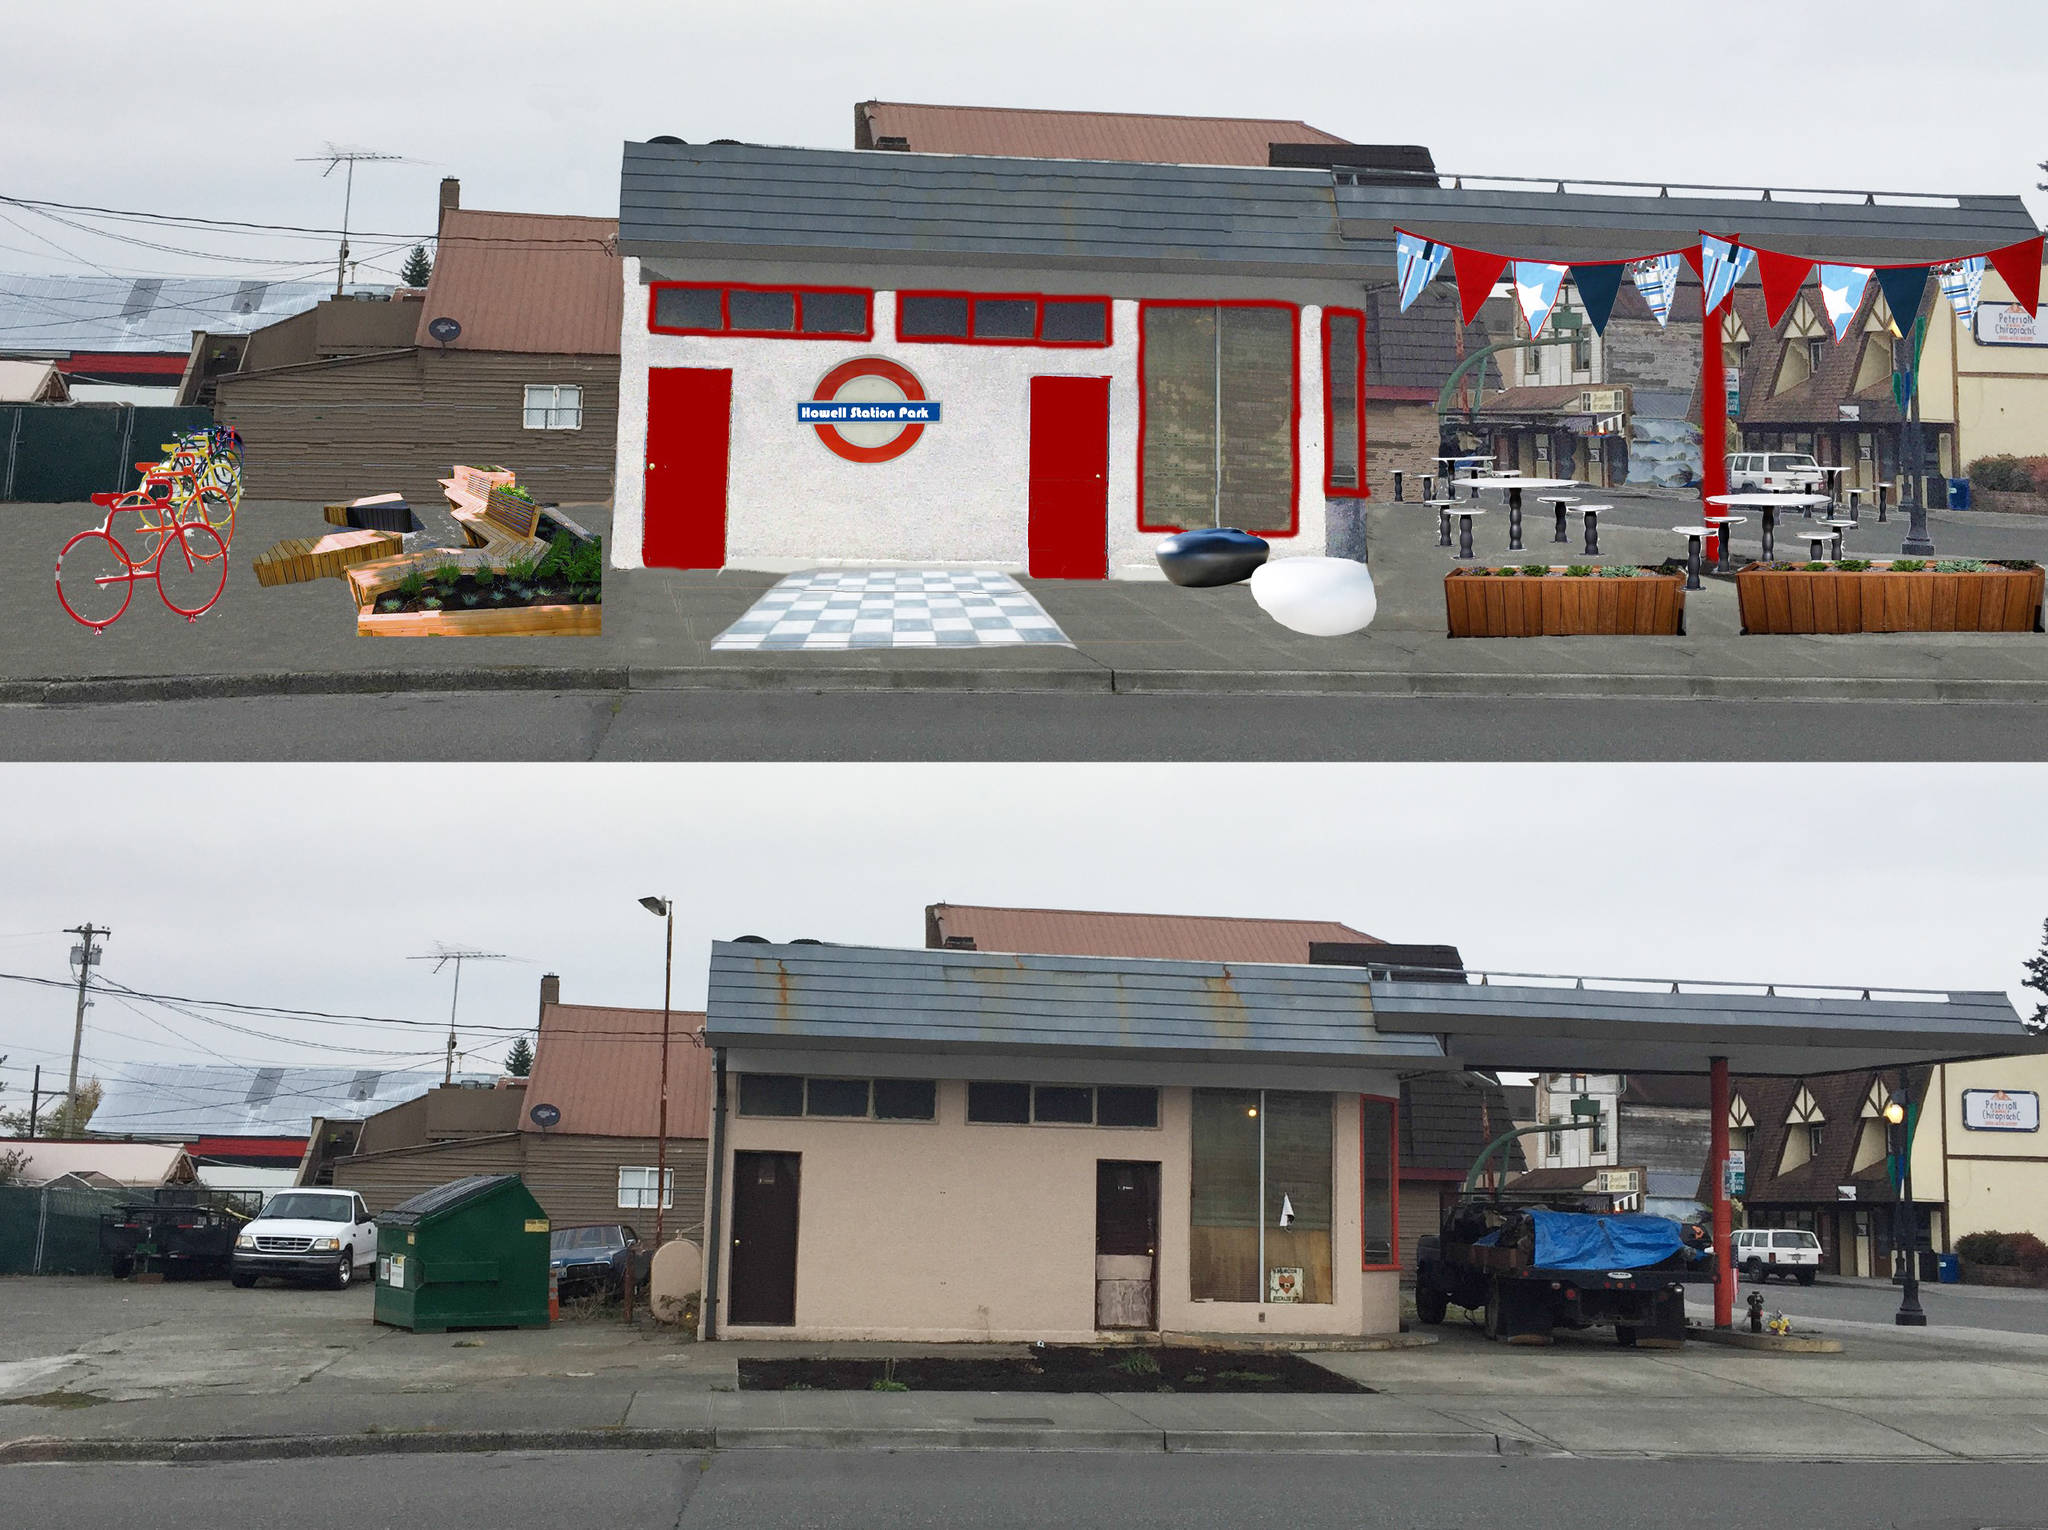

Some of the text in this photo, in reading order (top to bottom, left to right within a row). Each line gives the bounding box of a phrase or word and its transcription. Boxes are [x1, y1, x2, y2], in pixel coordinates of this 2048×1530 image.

[801, 406, 929, 419] Howell Station Park
